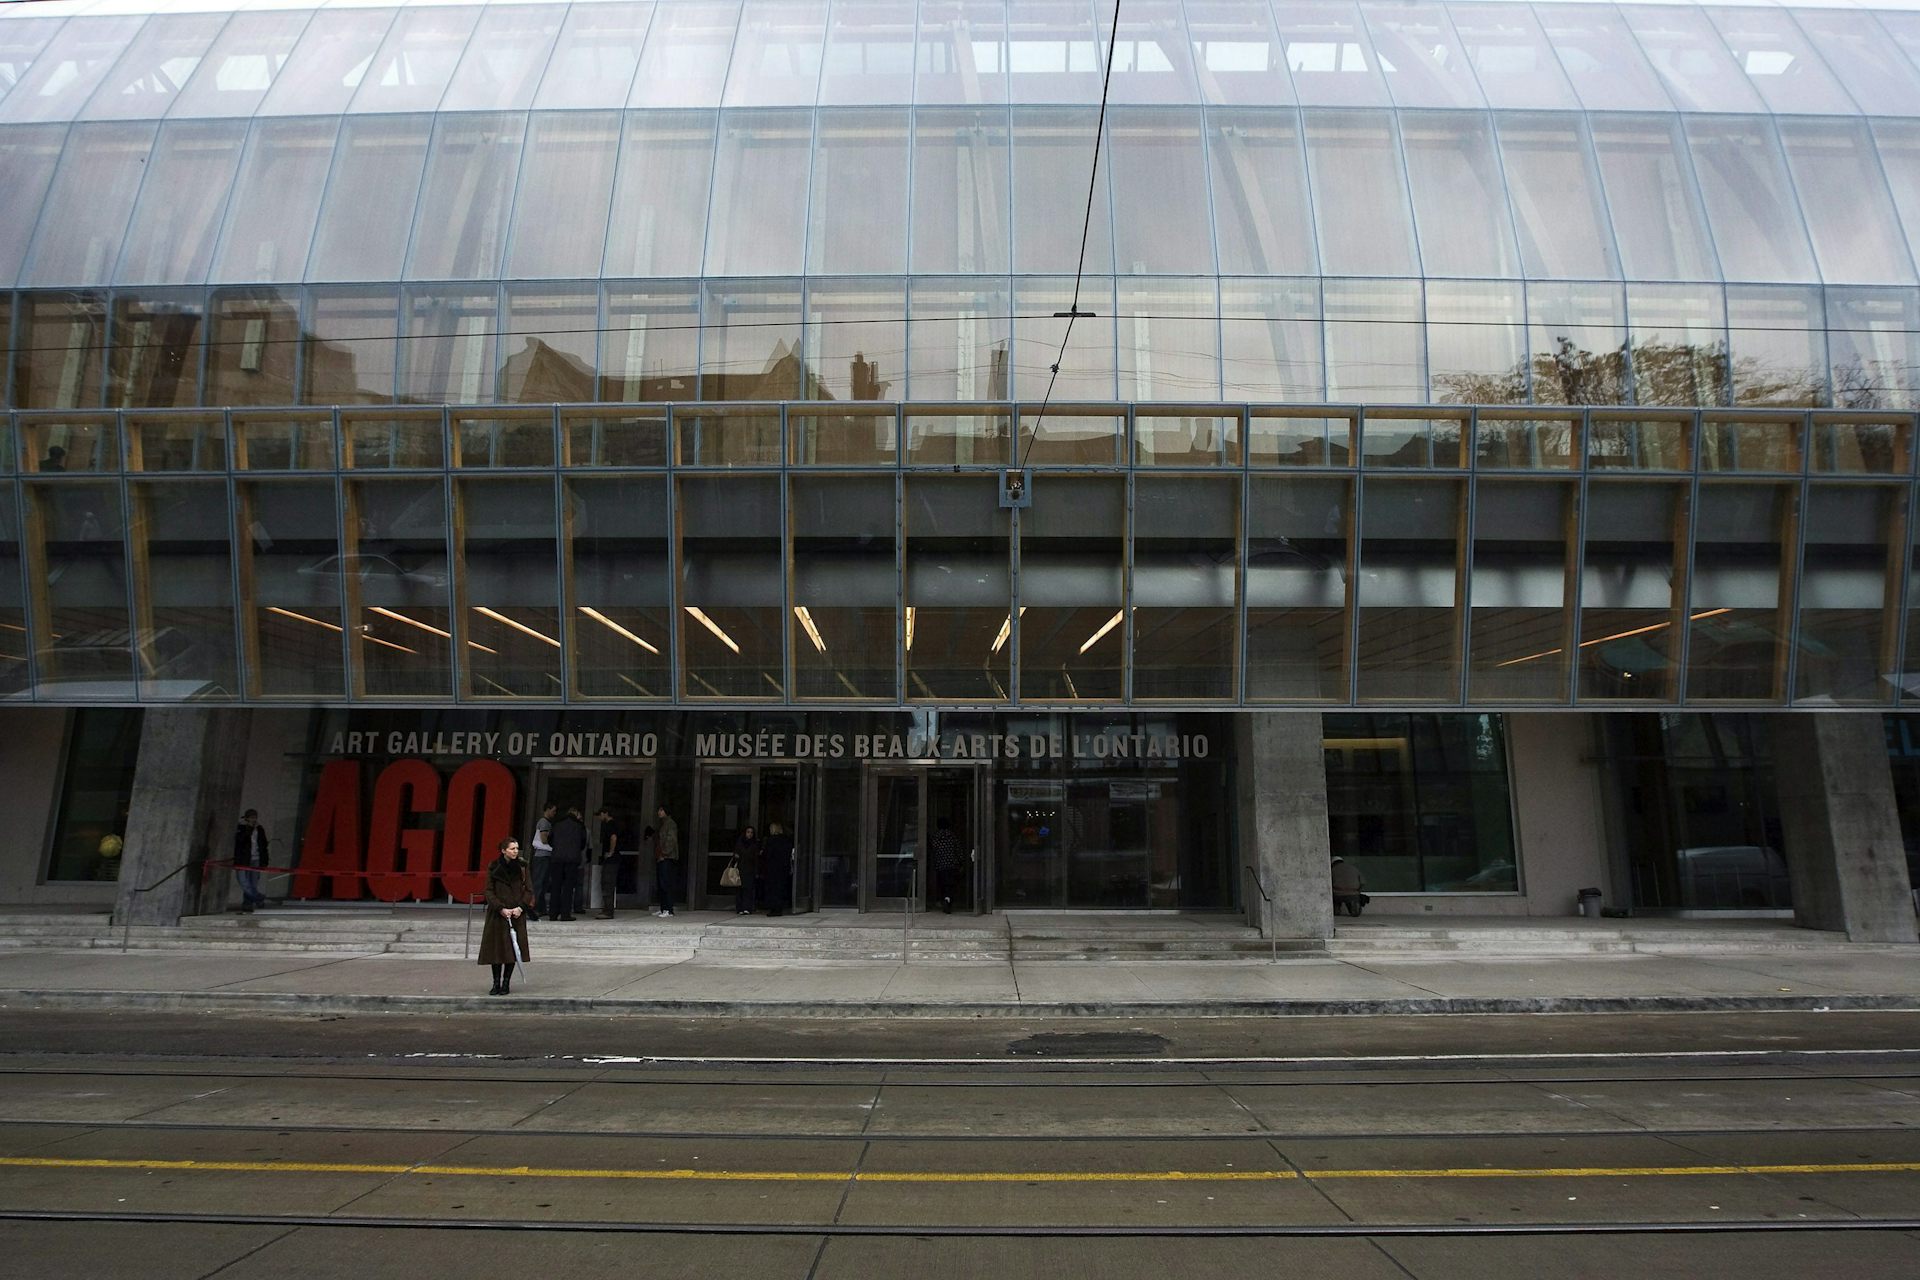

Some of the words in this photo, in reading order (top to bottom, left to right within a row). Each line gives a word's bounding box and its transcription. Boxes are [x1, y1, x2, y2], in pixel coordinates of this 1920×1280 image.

[330, 731, 380, 754] ART
[387, 731, 500, 755] GALLERY
[507, 731, 540, 756] OF
[549, 731, 658, 757] ONTARIO
[695, 728, 786, 757] MUSÉE
[795, 733, 845, 758] DES
[854, 733, 1020, 758] BEAUX-ARTS
[1030, 734, 1063, 758] DE
[1072, 734, 1209, 758] L'ONTARIO
[292, 758, 517, 903] AGO
